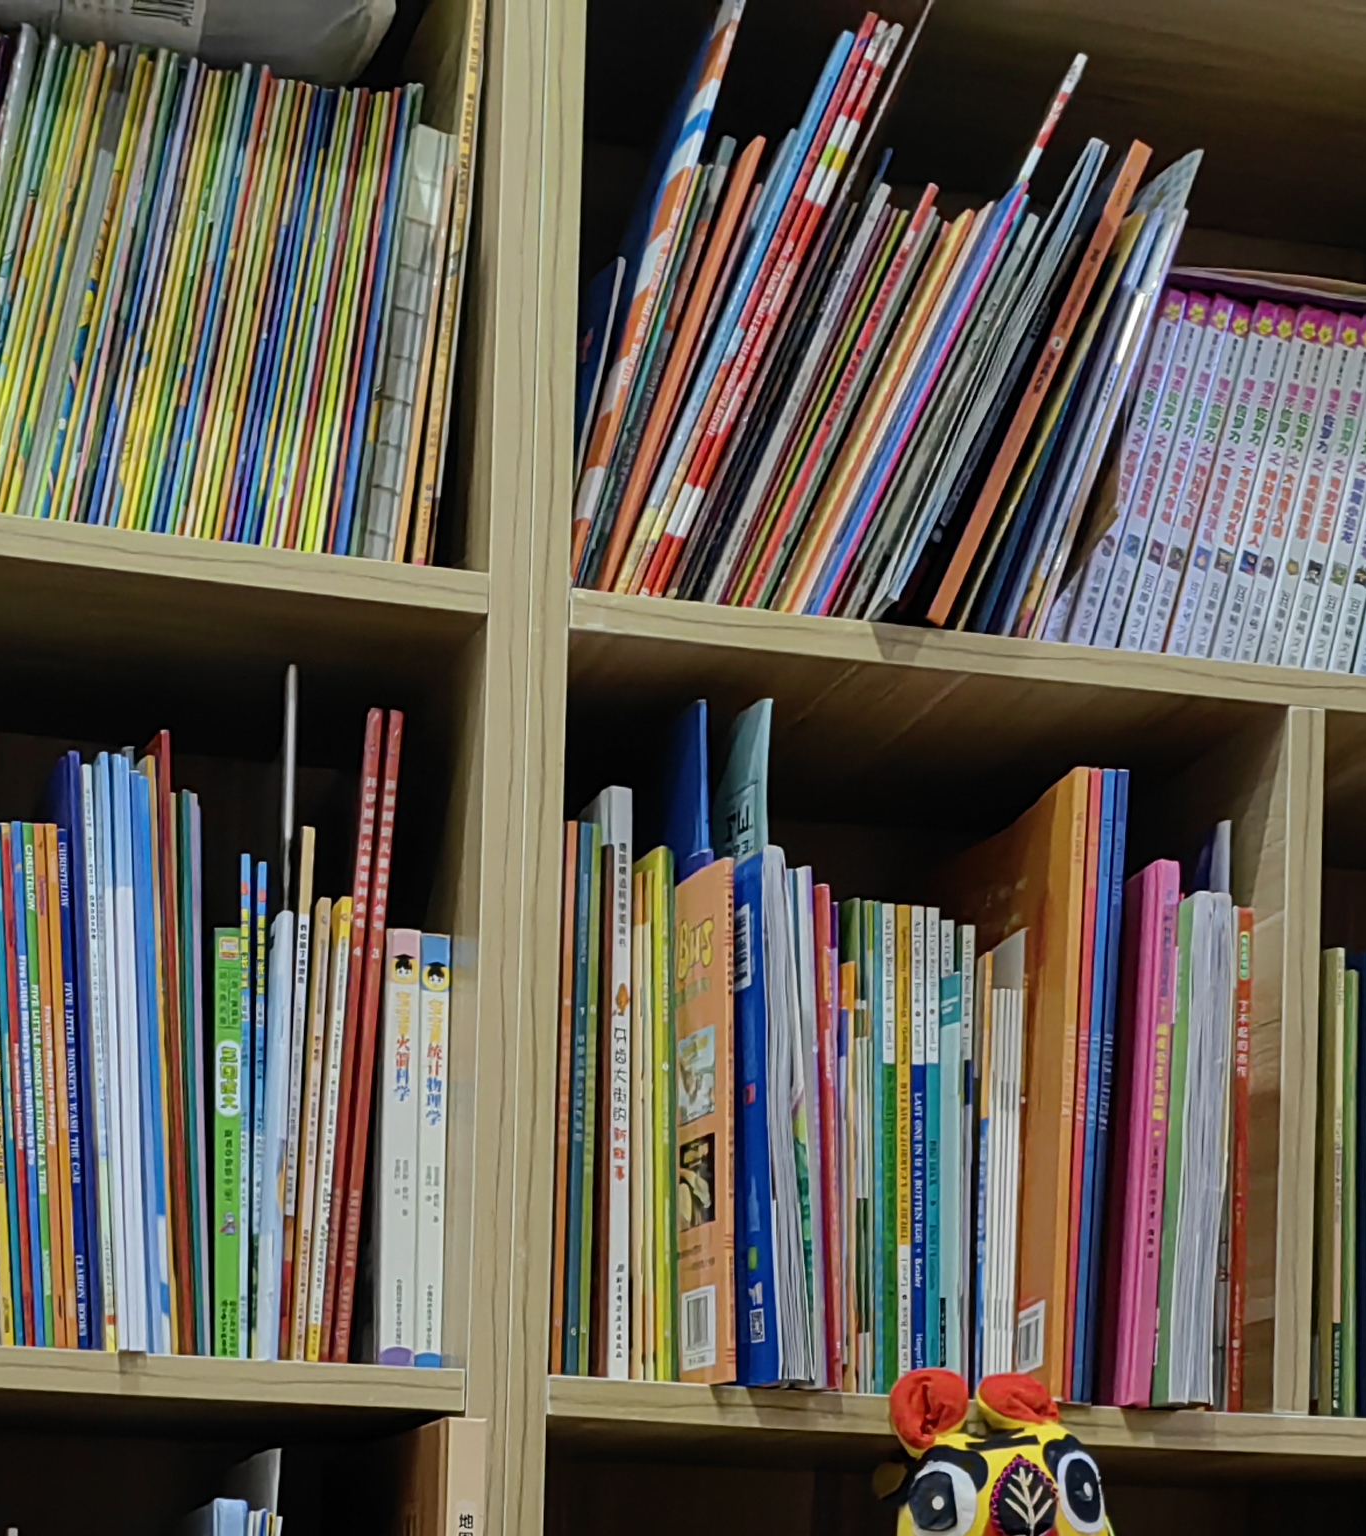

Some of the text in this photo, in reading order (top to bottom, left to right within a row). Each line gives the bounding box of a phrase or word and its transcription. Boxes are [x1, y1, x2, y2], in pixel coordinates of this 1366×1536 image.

[24, 844, 37, 911] CHRISTELOW
[59, 842, 69, 908] CHRISTELOW
[353, 947, 362, 956] 4
[613, 1027, 628, 1181] 牙齿大街的新故事
[914, 1092, 923, 1116] LAST
[915, 1119, 923, 1140] ONE
[915, 1144, 923, 1154] IN
[915, 1158, 923, 1167] IS
[916, 1180, 924, 1219] ROTTEN
[916, 1223, 925, 1242] EGG
[75, 1255, 87, 1336] CLARION BOOKS
